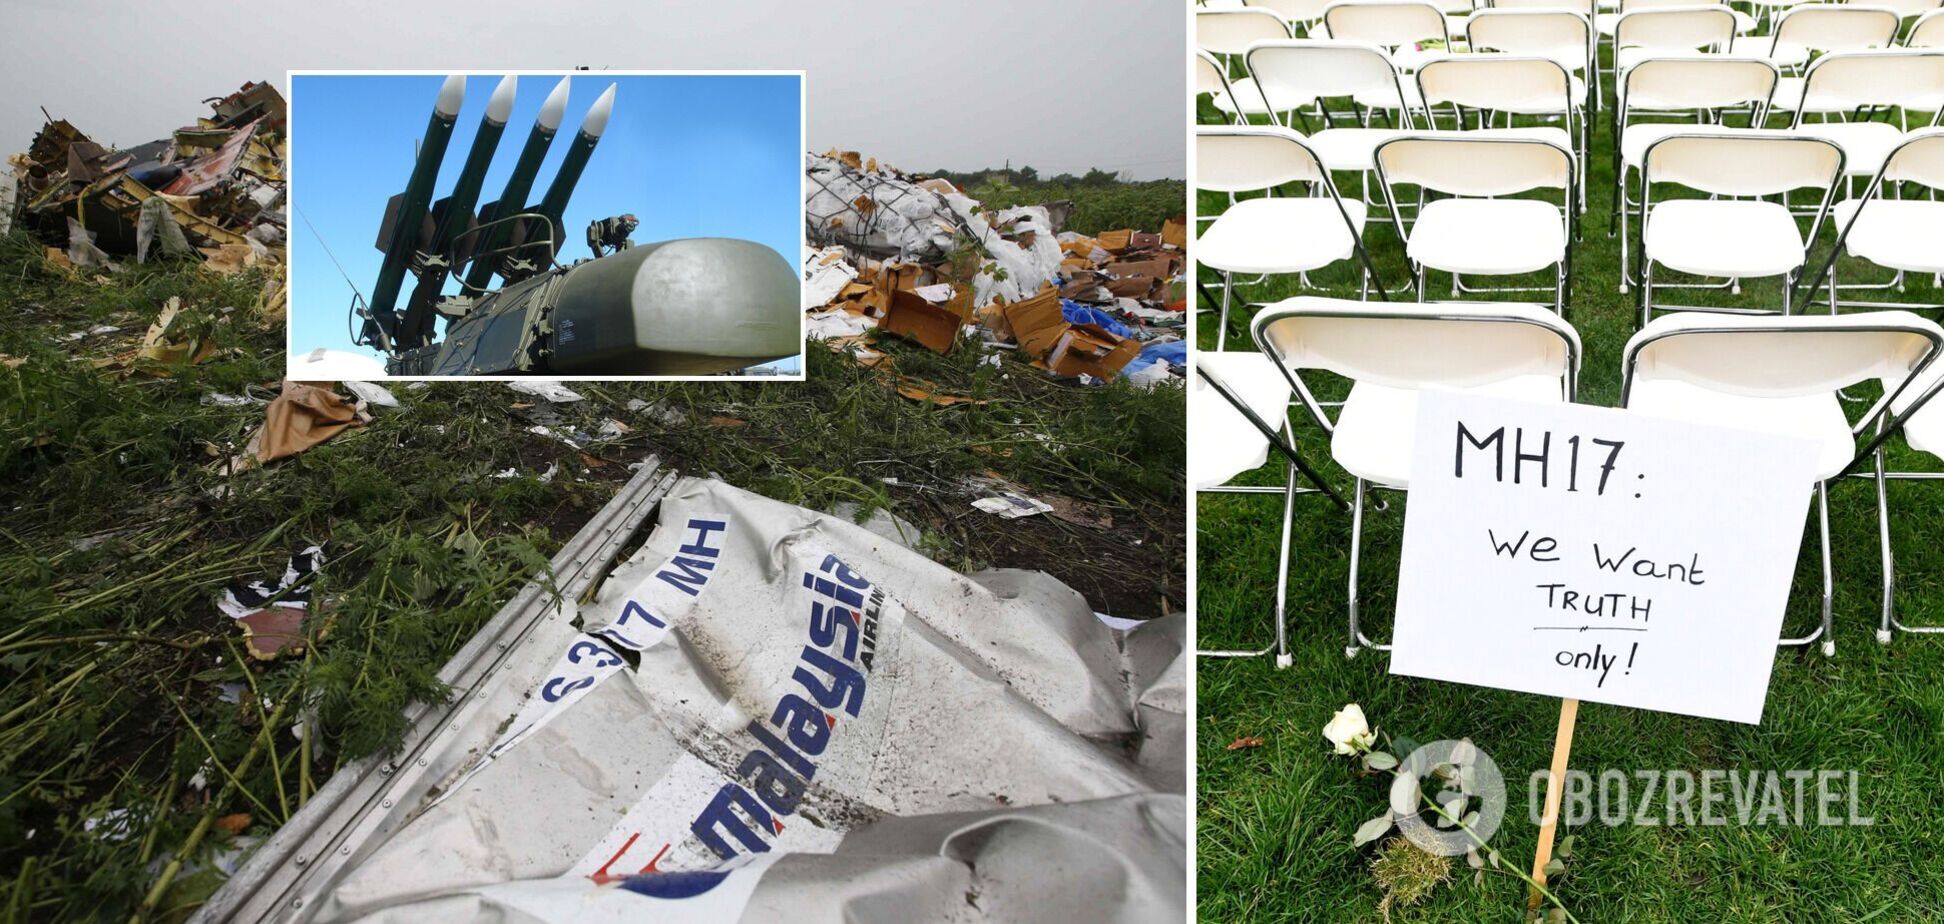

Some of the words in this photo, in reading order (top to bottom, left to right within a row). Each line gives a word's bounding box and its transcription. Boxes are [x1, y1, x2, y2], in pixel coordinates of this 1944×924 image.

[1454, 420, 1645, 499] MH17:
[656, 518, 727, 597] MH
[860, 585, 886, 673] AIRLIN
[1536, 583, 1652, 622] TRUTH
[690, 553, 871, 860] malaysia
